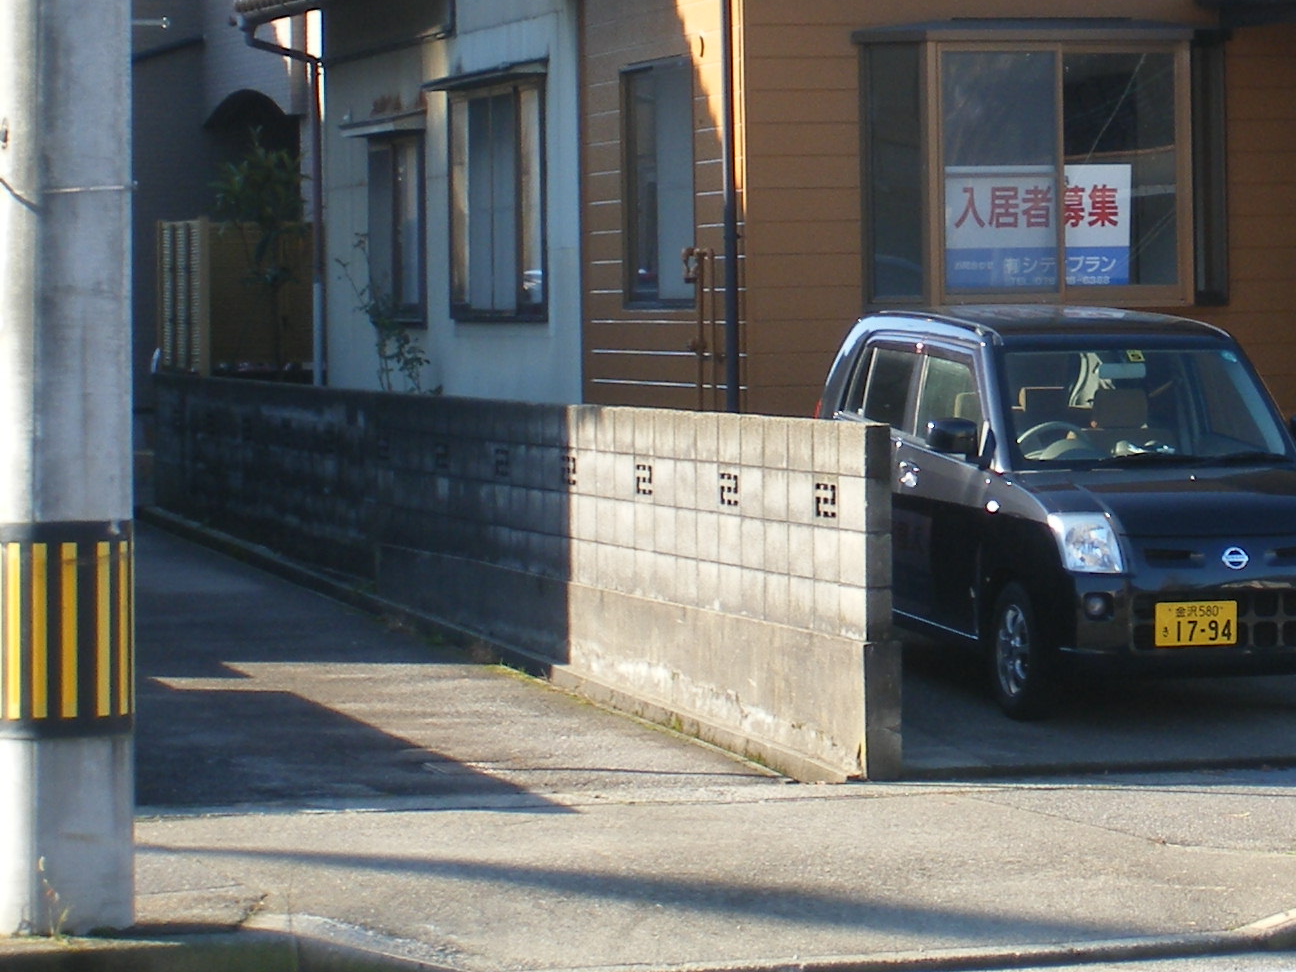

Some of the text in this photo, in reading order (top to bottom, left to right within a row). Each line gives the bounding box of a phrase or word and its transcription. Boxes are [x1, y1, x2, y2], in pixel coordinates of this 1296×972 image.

[954, 184, 1119, 229] 入居者募集
[1176, 606, 1219, 617] 金沢580
[1177, 619, 1232, 642] 17-94
